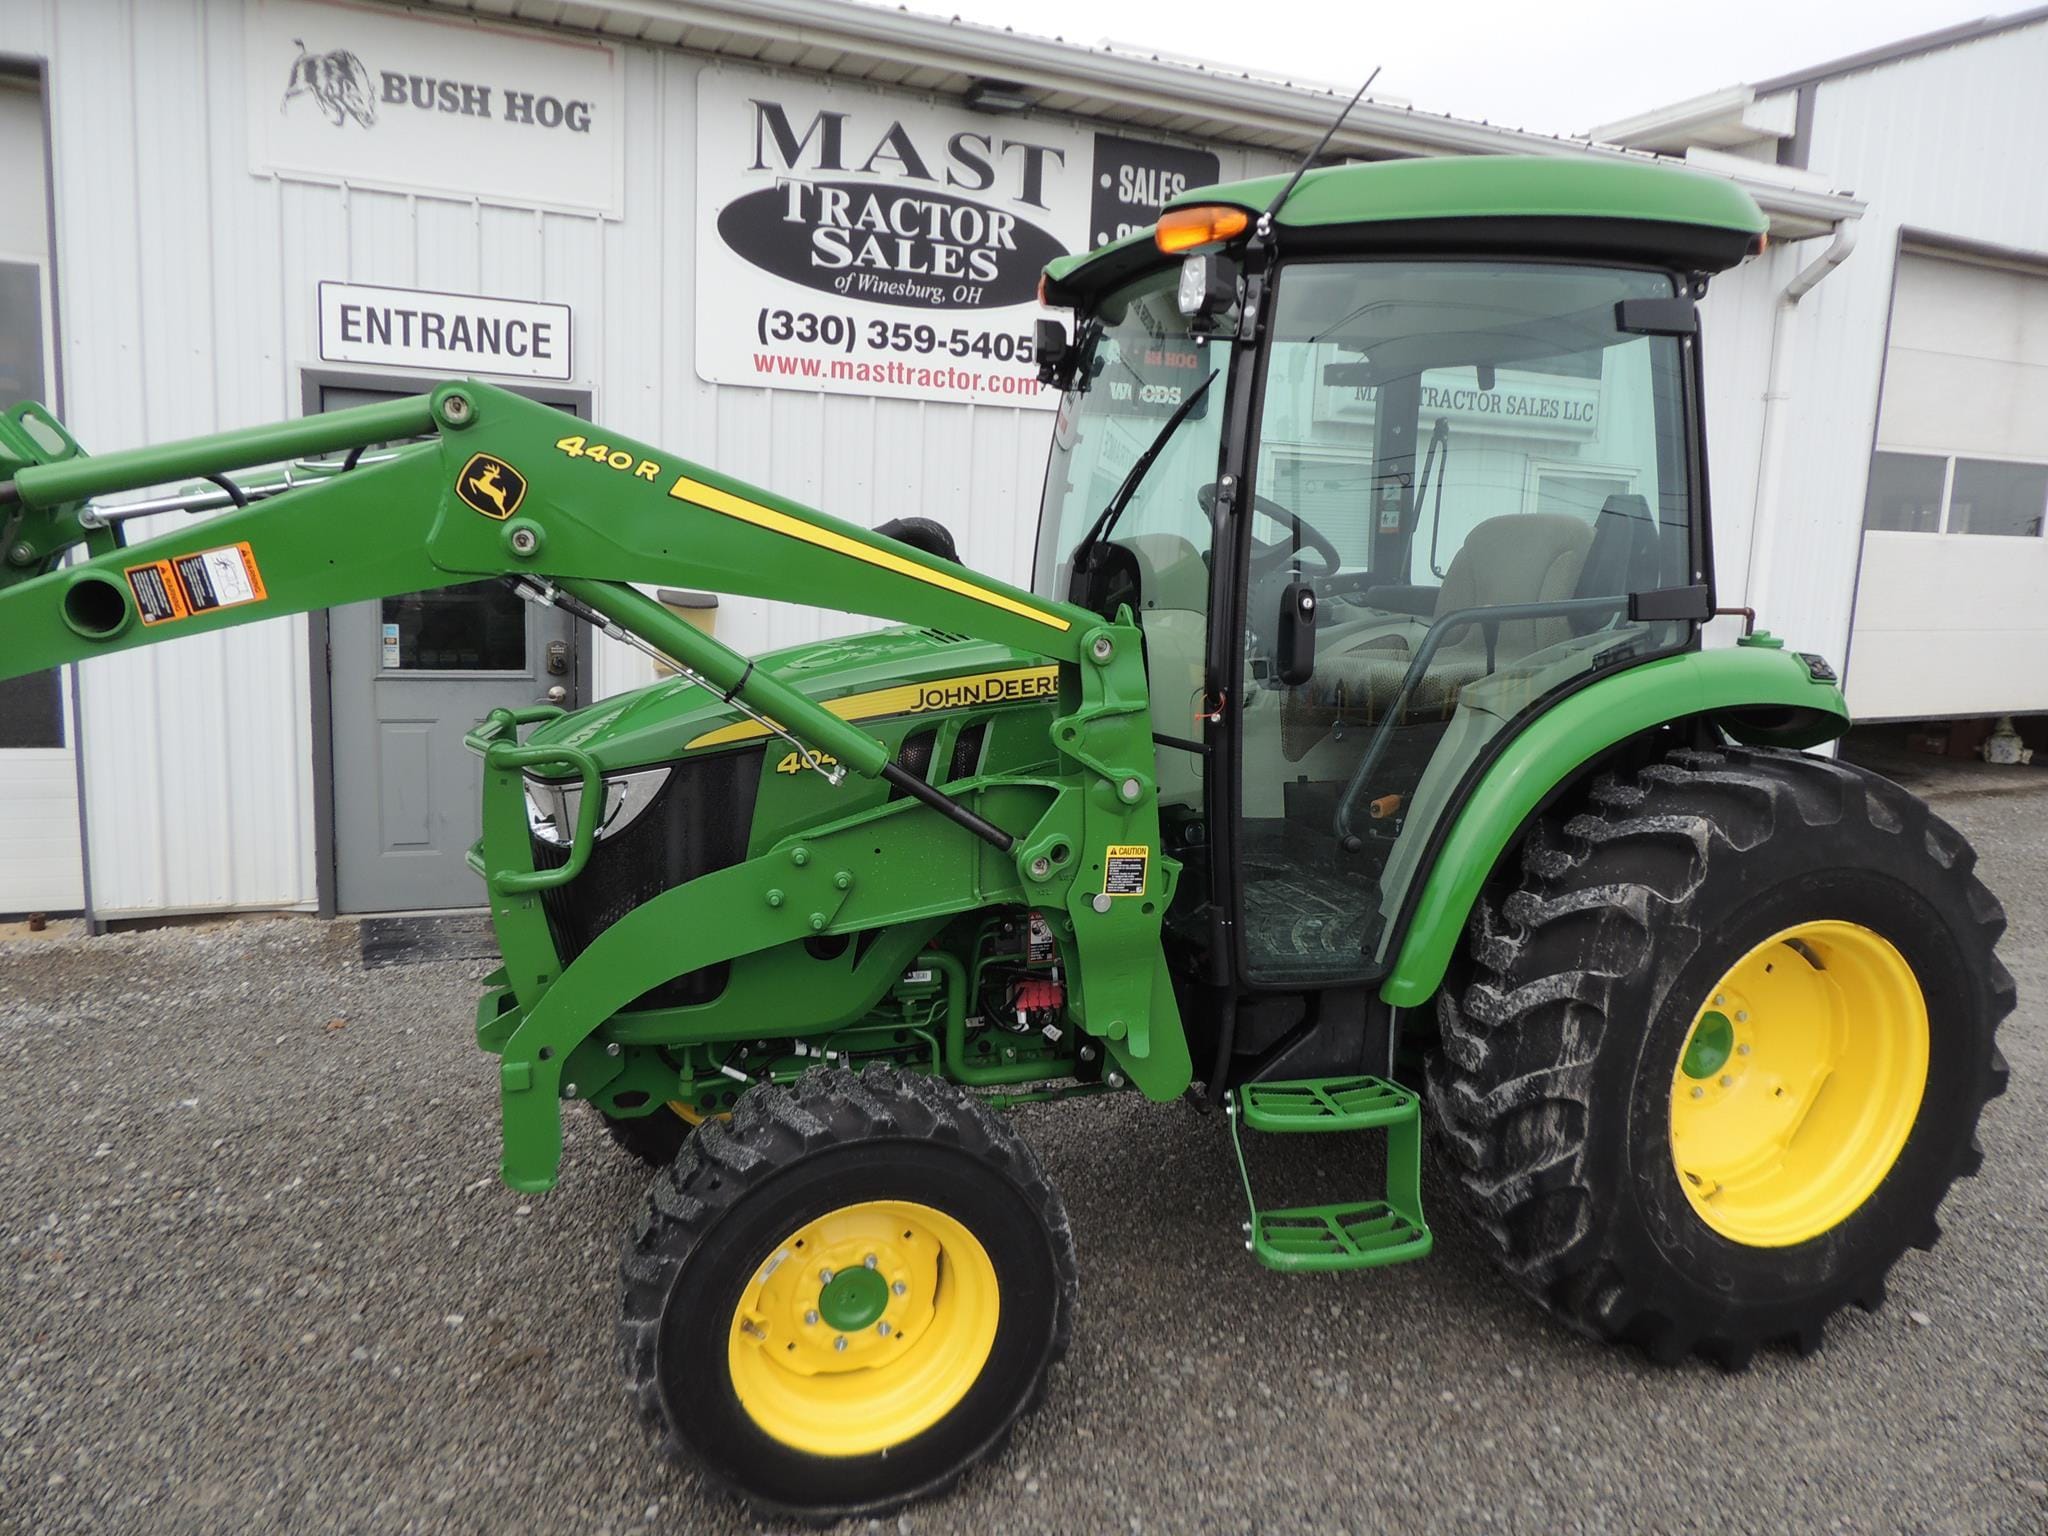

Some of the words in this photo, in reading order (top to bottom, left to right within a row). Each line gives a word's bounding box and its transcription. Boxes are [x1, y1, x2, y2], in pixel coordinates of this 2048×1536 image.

[380, 69, 492, 119] BUSH
[503, 89, 592, 133] HOG
[747, 98, 1066, 212] MAST
[1118, 164, 1187, 207] SALES
[775, 176, 1018, 251] TRACTOR
[811, 227, 999, 283] SALES
[834, 271, 857, 293] of
[858, 274, 947, 303] Winesburg,
[952, 285, 984, 304] OH
[341, 303, 552, 359] ENTRANCE
[757, 308, 857, 353] (330)
[867, 320, 1035, 364] 359-5405
[753, 353, 1040, 396] www.masttractor.com
[1164, 352, 1199, 369] HOG
[1418, 386, 1502, 414] TRACTOR
[1506, 396, 1559, 419] SALES
[1563, 400, 1594, 422] LLC
[910, 684, 981, 710] JOHN
[1118, 846, 1148, 856] CAUTION
